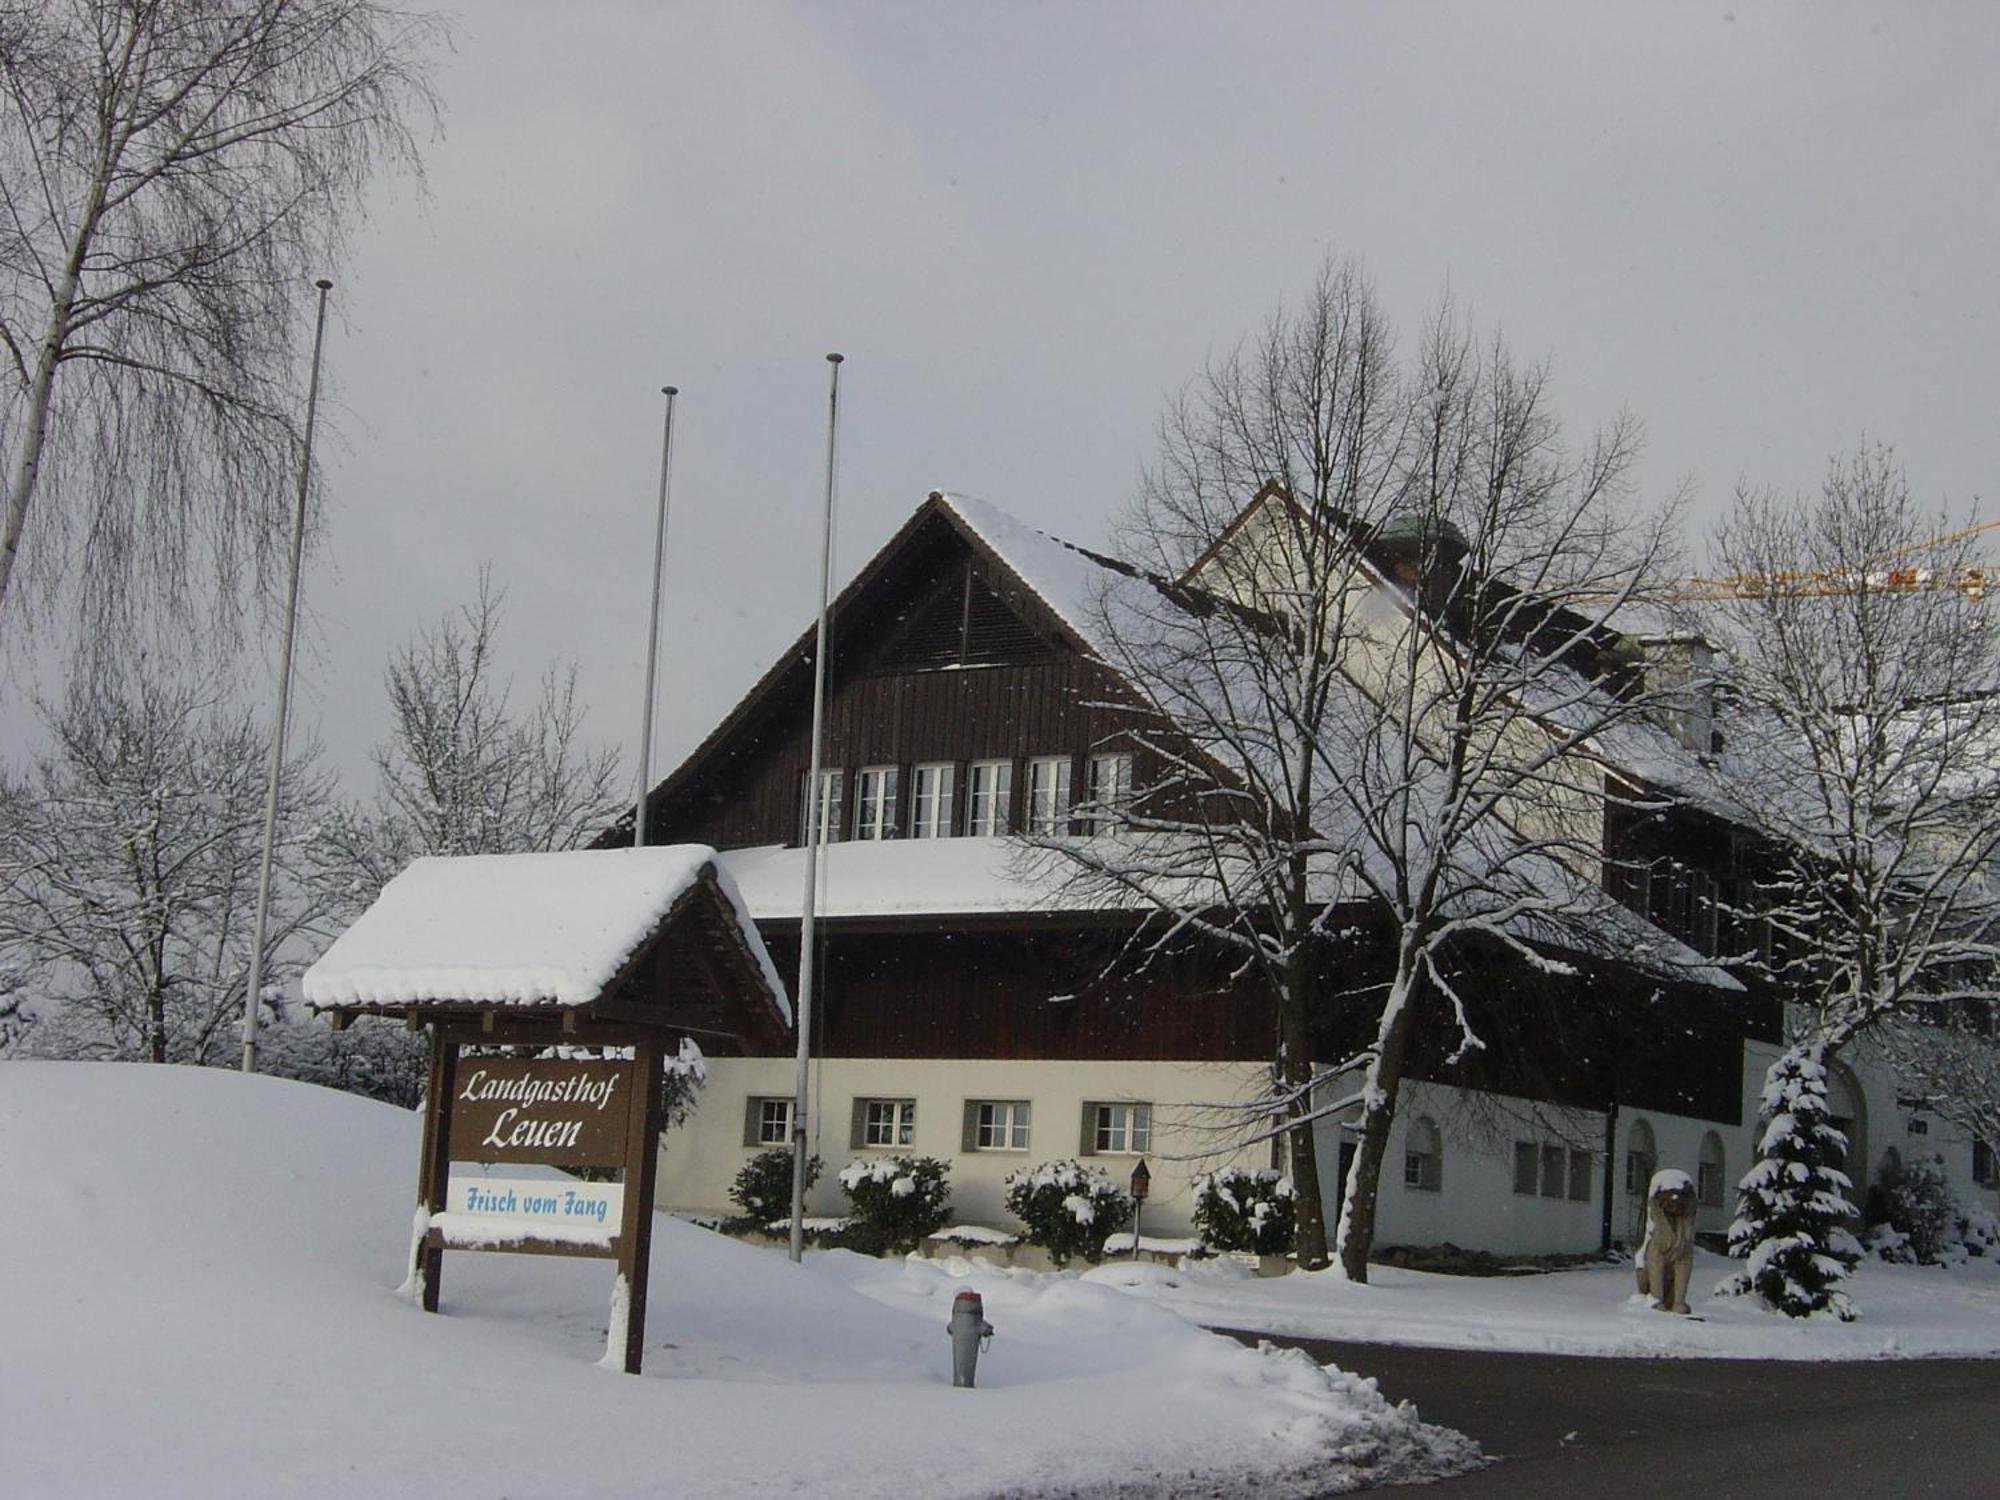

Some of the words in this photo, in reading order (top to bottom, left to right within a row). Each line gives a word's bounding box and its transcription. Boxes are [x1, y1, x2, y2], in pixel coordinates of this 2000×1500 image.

[459, 1070, 619, 1110] Landgasthof
[482, 1108, 583, 1148] Leuen
[467, 1187, 516, 1212] Frisch
[523, 1197, 557, 1214] vom
[565, 1191, 608, 1223] Fang
